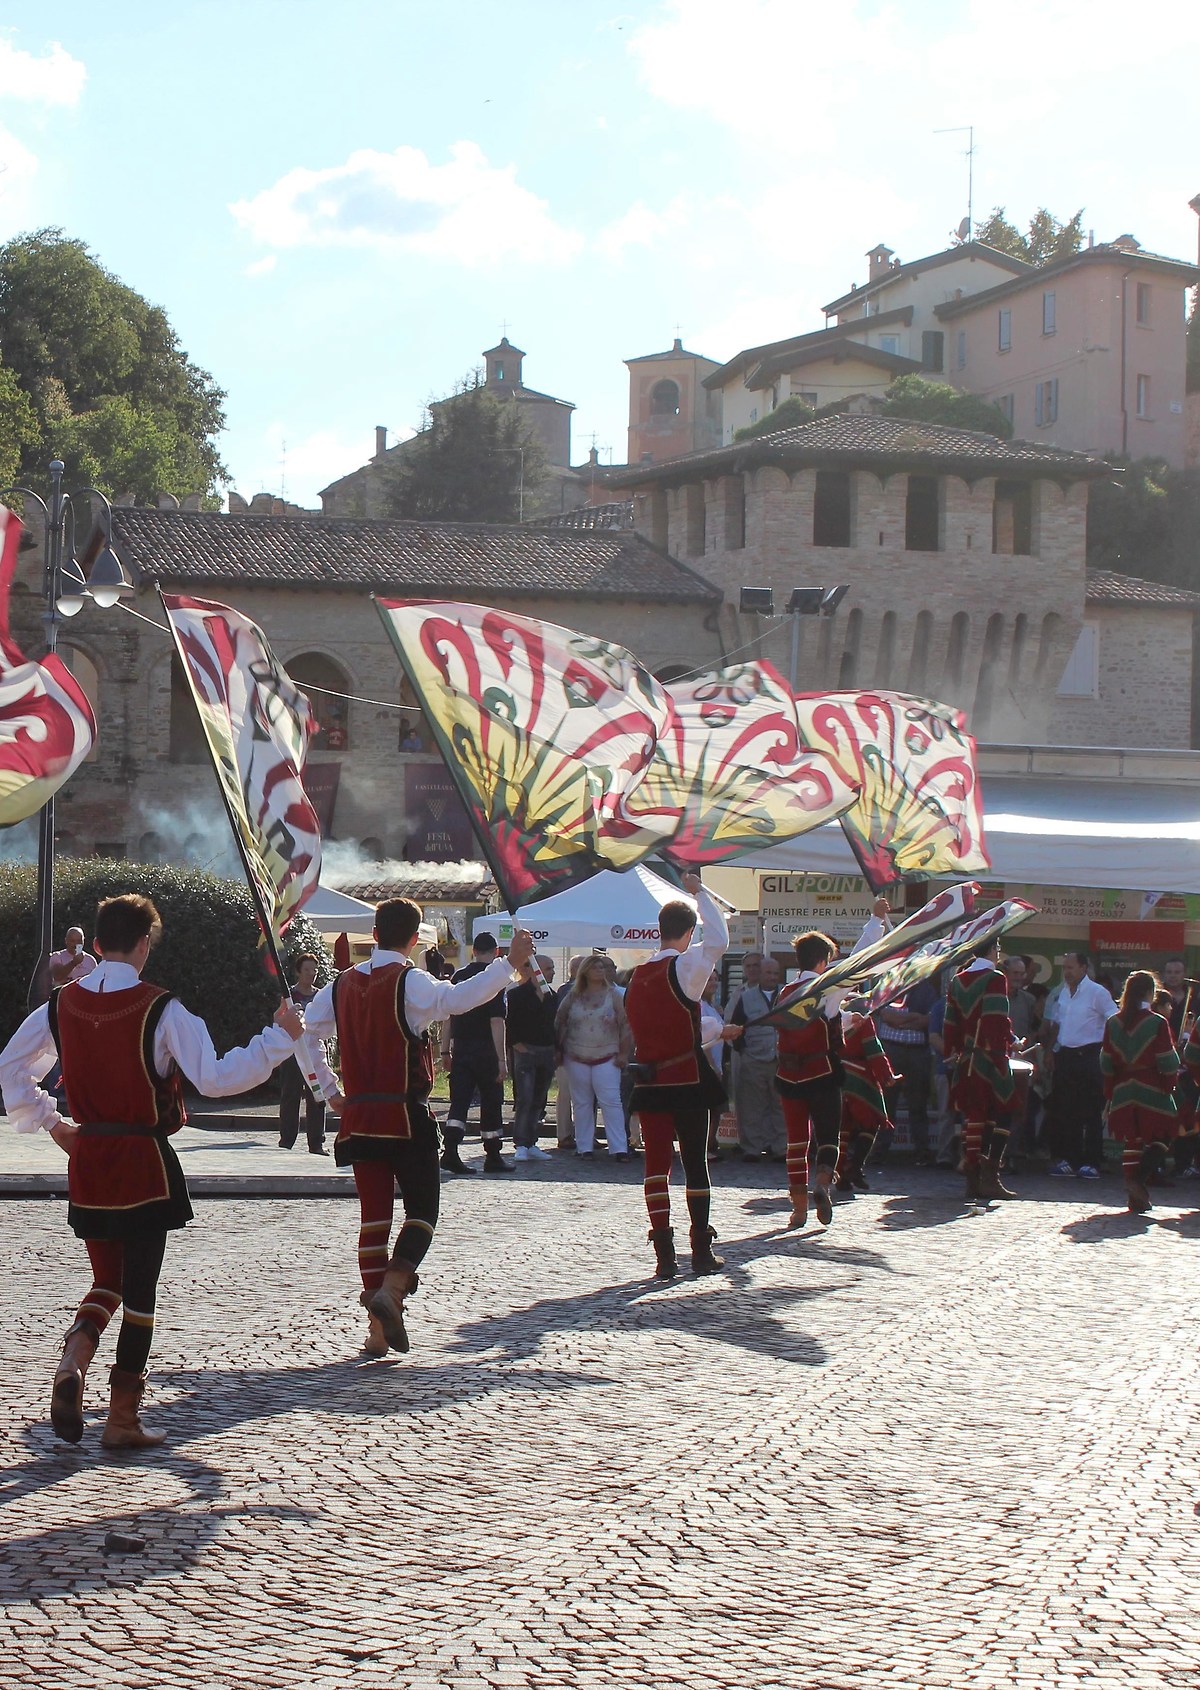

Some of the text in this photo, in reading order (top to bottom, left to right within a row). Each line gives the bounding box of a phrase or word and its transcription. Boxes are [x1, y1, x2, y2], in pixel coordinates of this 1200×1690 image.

[427, 832, 451, 841] FESTA
[1043, 897, 1057, 906] TEL
[762, 908, 871, 917] FINESTRE PER LA VITA
[1041, 907, 1058, 915] FAX
[623, 928, 661, 940] ADMO
[1100, 942, 1151, 950] MARSHALL
